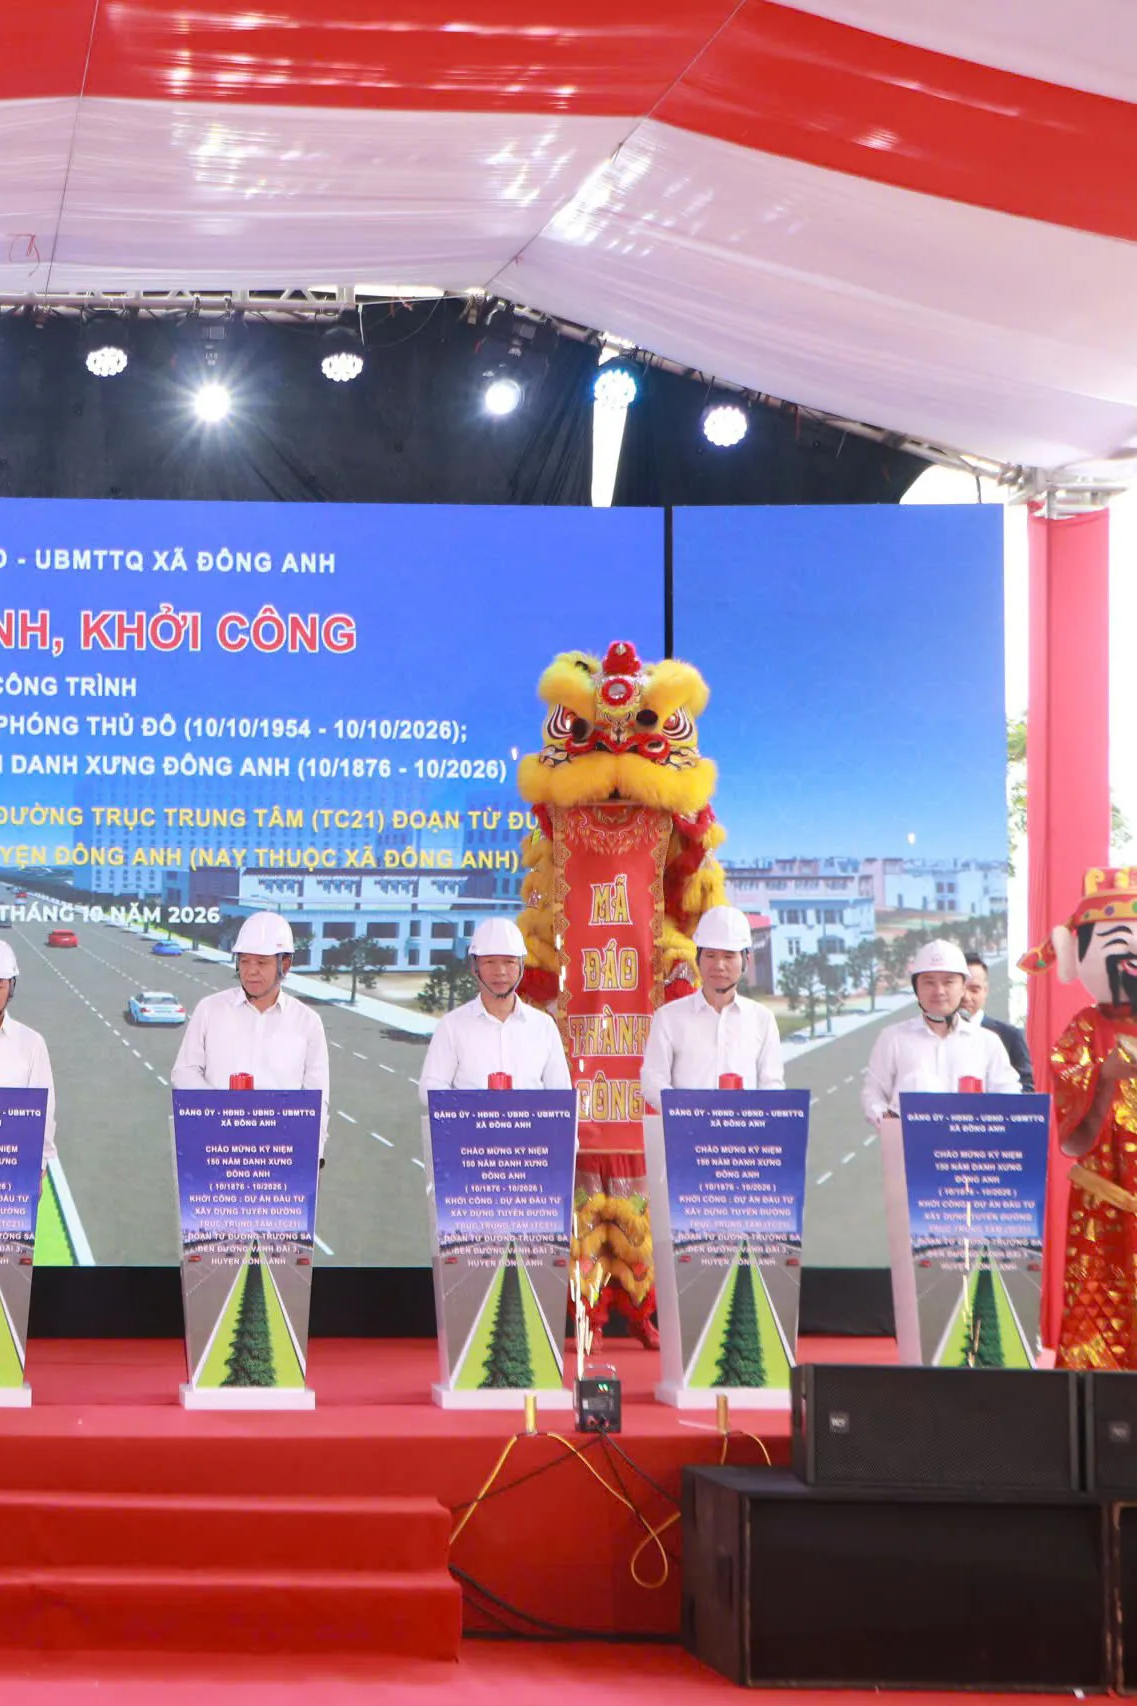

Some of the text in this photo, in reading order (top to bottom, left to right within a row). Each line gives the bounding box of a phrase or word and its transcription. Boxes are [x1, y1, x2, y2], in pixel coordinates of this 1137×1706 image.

[35, 548, 144, 572] UBMTTQ
[152, 547, 188, 571] XÃ
[196, 547, 272, 573] ĐÔNG
[281, 552, 335, 574] ANH
[80, 602, 202, 652] KHỞI
[216, 604, 357, 654] CÔNG
[65, 672, 137, 697] TRÌNH
[86, 713, 134, 737] THỦ
[141, 713, 177, 737] ĐÔ
[184, 717, 311, 741] (10/10/1954
[334, 719, 467, 745] 10/10/2026);
[11, 754, 78, 774] DANH
[85, 755, 156, 776] XƯNG
[162, 752, 233, 777] ĐÔNG
[239, 757, 290, 777] ANH
[298, 757, 391, 783] (10/1876
[414, 759, 507, 784] 10/2026)
[92, 807, 155, 831] TRỤC
[165, 808, 246, 828] TRUNG
[254, 805, 304, 829] TÂM
[312, 809, 384, 832] (TC21)
[392, 810, 460, 834] ĐOẠN
[468, 807, 502, 830] TỪ
[54, 842, 125, 866] ĐÔNG
[132, 847, 182, 866] ANH
[190, 848, 247, 871] (NAY
[254, 847, 337, 872] THUỘC
[344, 845, 377, 868] XÃ
[384, 846, 454, 869] ĐÔNG
[461, 849, 519, 874] ANH)
[82, 906, 103, 922] 10
[112, 902, 161, 923] NĂM
[168, 907, 221, 923] 2026
[589, 874, 632, 925] MÃ
[582, 938, 638, 991] ĐÁO
[568, 1005, 651, 1057] THÀNH
[576, 1071, 644, 1123] CÔNG
